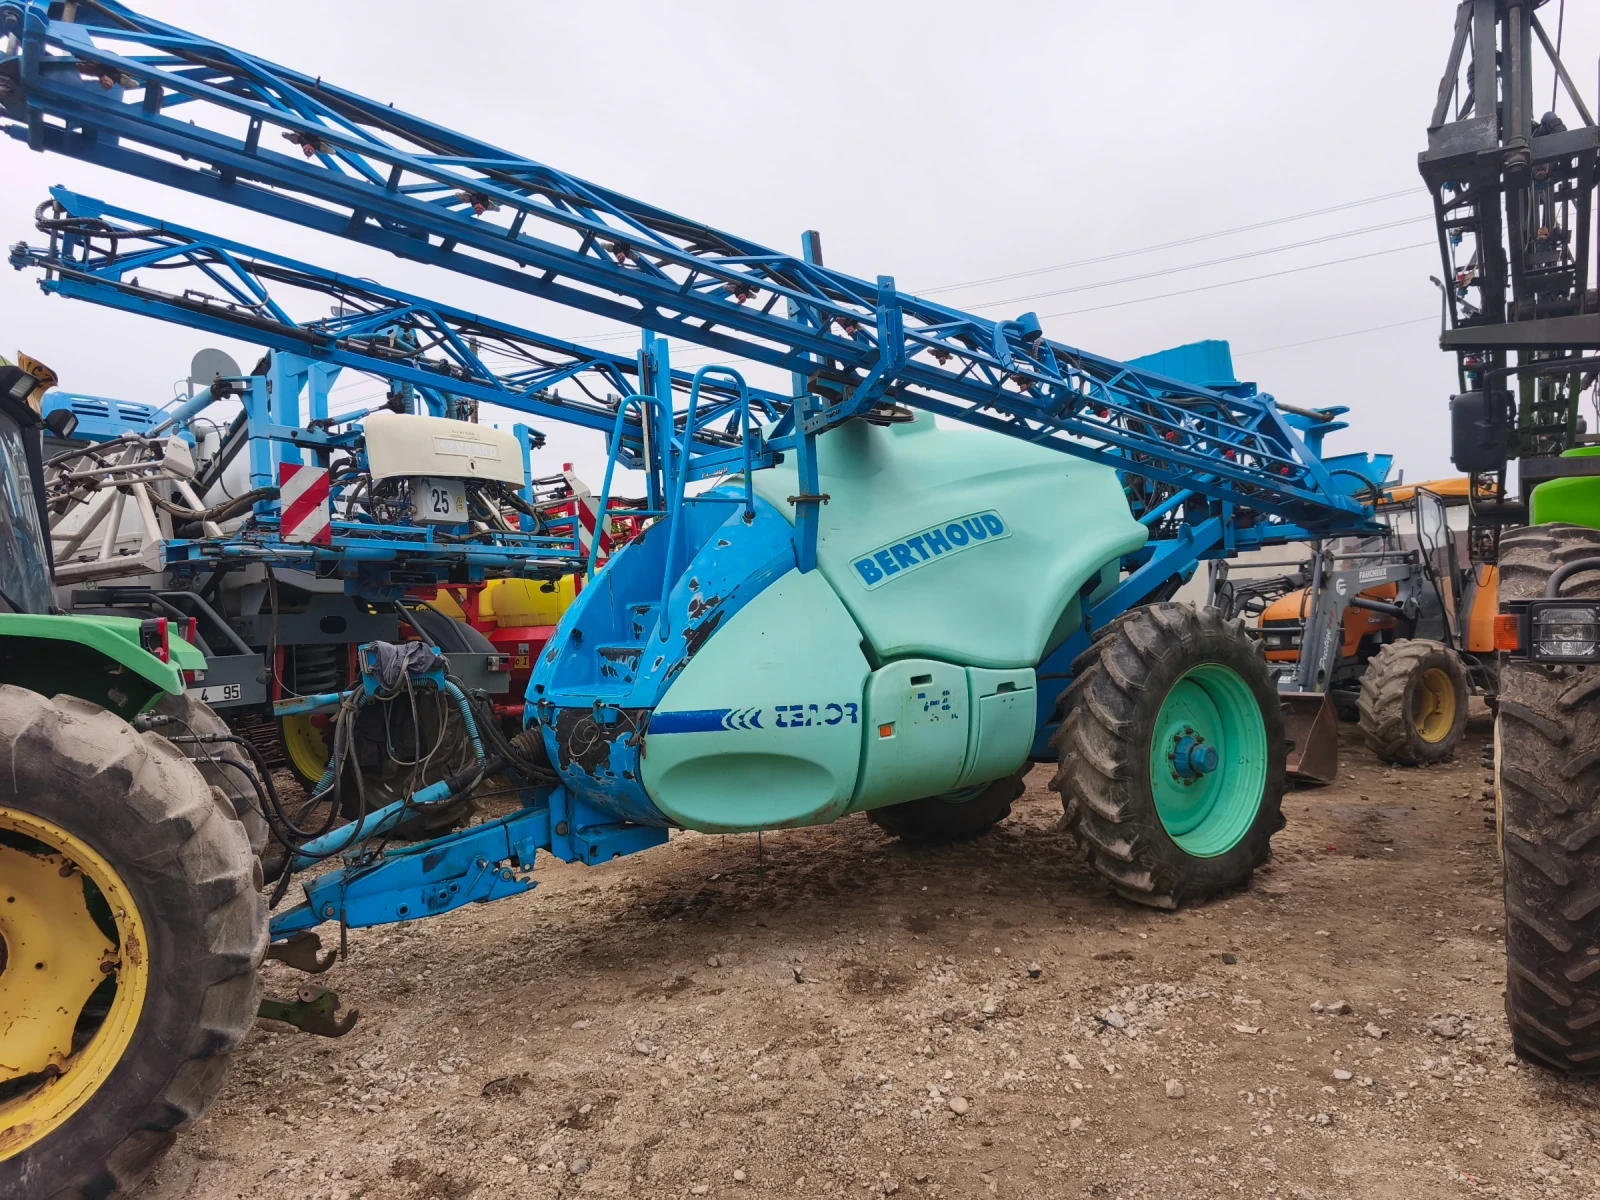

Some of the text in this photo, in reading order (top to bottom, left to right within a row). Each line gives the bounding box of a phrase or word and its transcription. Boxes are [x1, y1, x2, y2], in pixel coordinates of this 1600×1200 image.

[432, 489, 449, 513] 25
[854, 514, 1003, 585] BERTHOUD
[1359, 568, 1387, 579] FAUCHEUX
[201, 685, 239, 701] 4 95
